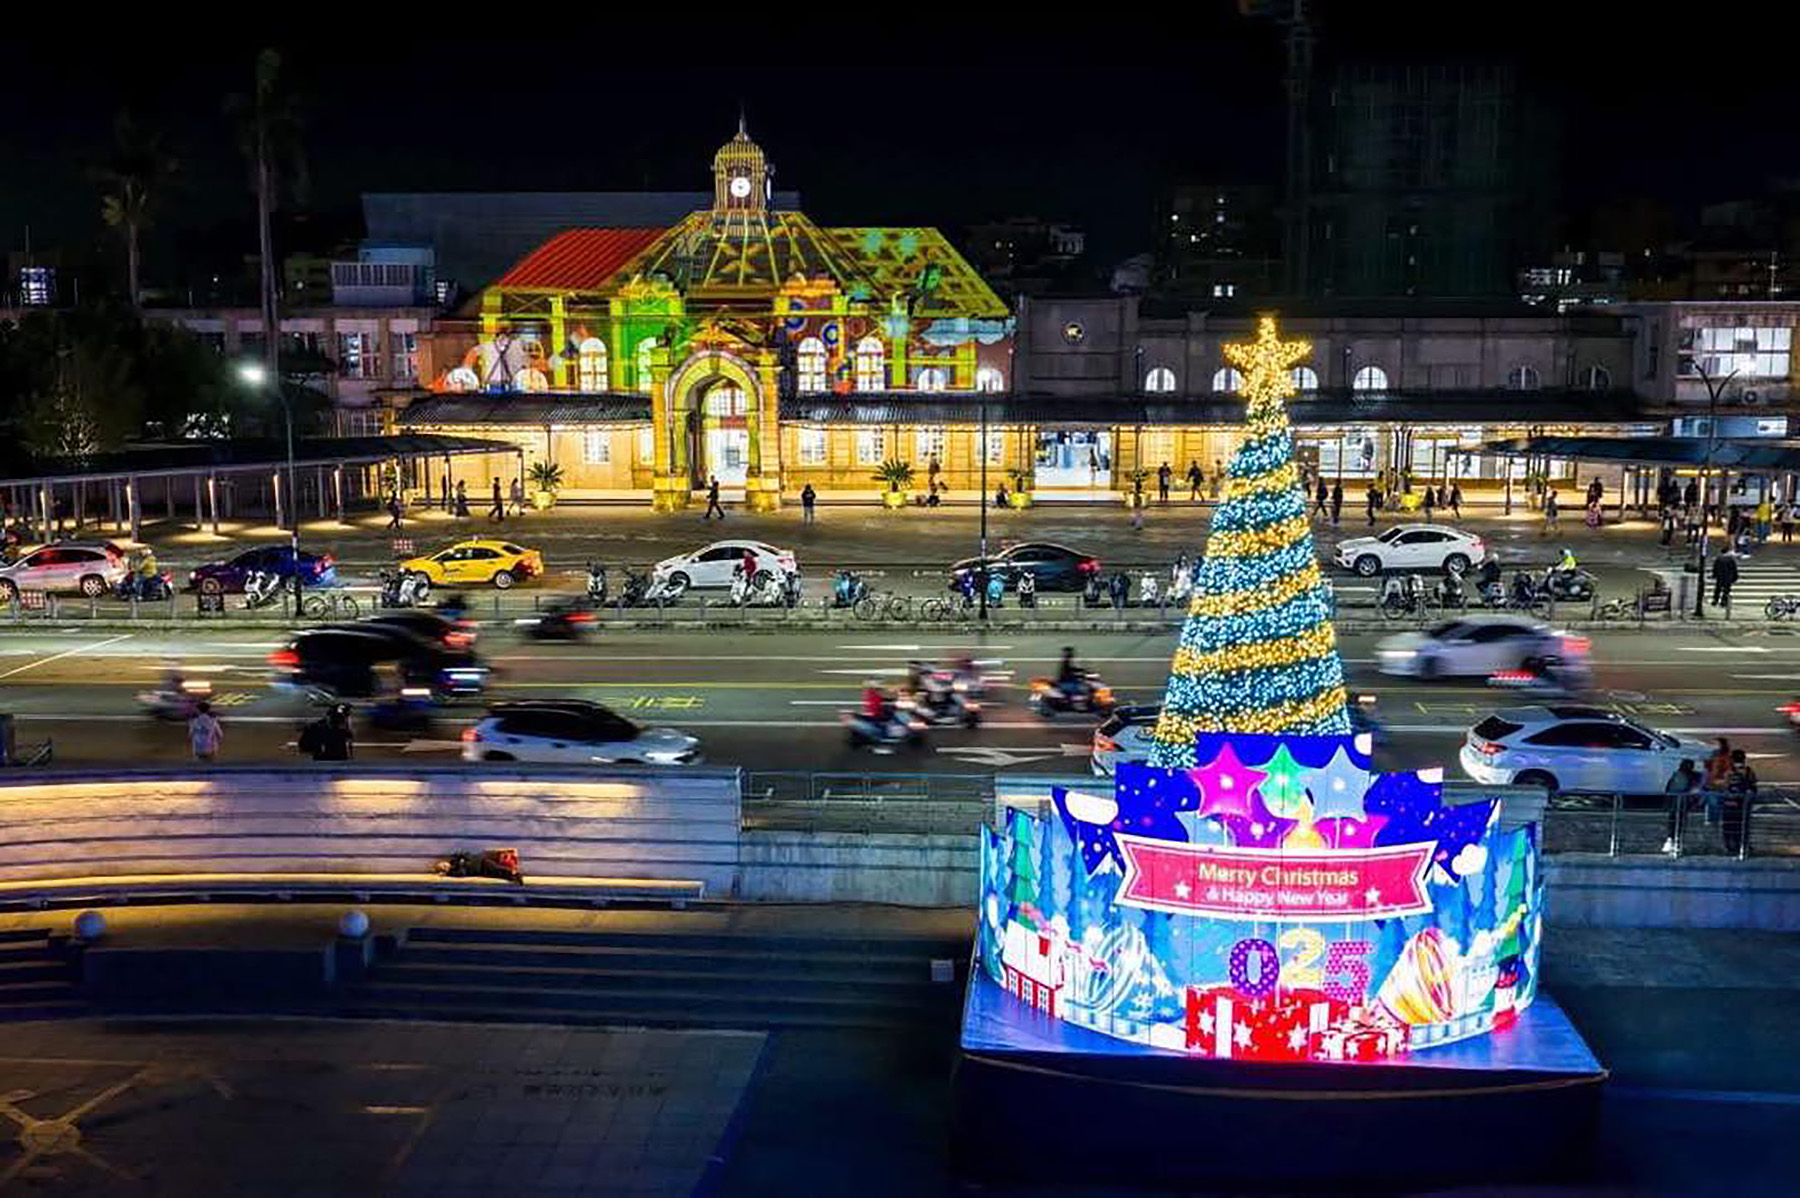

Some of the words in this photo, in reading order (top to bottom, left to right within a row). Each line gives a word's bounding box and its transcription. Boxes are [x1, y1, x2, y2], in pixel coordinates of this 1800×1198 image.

[1199, 863, 1257, 888] Merry
[1261, 866, 1360, 886] Christmas
[1222, 887, 1275, 906] Happy
[1277, 890, 1313, 906] New
[1317, 889, 1349, 905] Year
